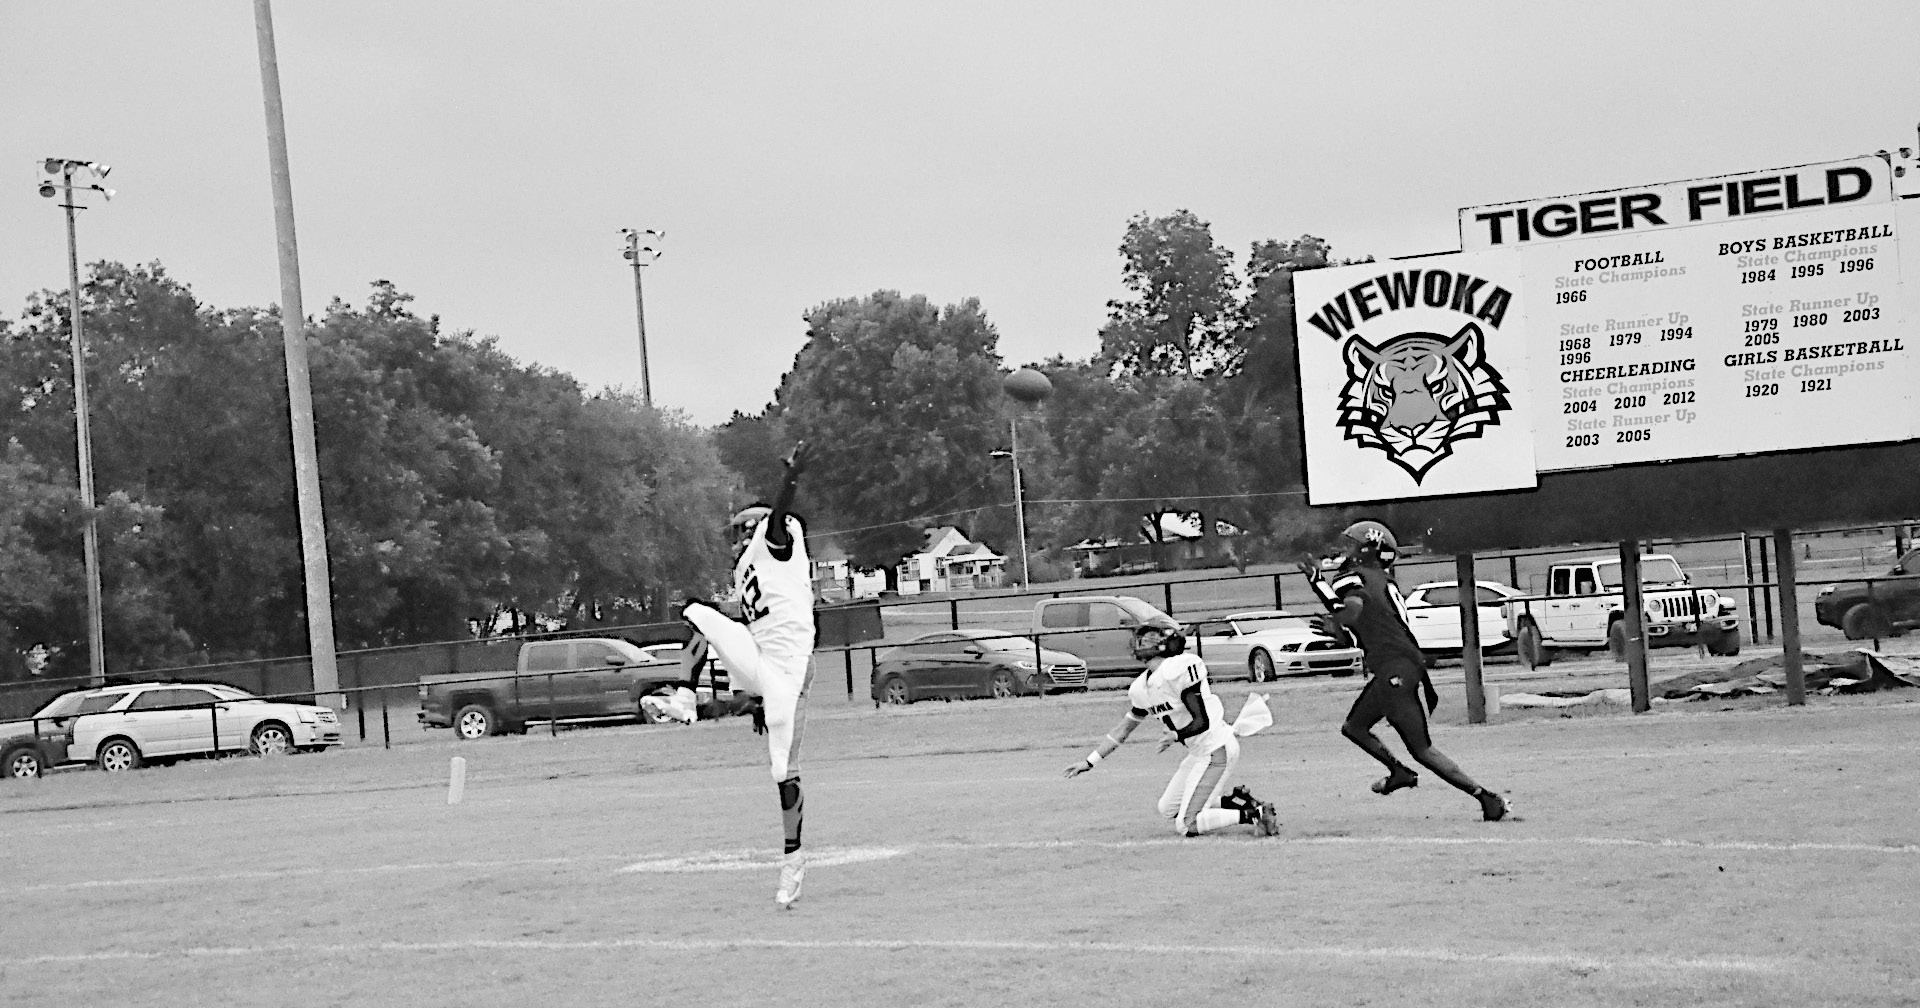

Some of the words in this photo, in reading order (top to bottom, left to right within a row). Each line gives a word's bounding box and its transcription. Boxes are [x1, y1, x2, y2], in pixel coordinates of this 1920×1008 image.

[1476, 192, 1668, 245] TIGER
[1687, 166, 1872, 221] FIELD
[1718, 239, 1766, 256] BOYS
[1773, 225, 1892, 250] BASKETBALL
[1574, 251, 1664, 272] FOOTBALL
[1737, 255, 1779, 268] State
[1784, 244, 1877, 263] Champions
[1555, 276, 1594, 288] State
[1599, 266, 1686, 283] Champions
[1742, 269, 1776, 283] 1984
[1791, 264, 1824, 278] 1995
[1840, 258, 1874, 273] 1996
[1307, 268, 1513, 342] WEWOKA
[1556, 290, 1587, 304] 1966
[1742, 305, 1783, 317] State
[1789, 296, 1851, 313] Runner
[1857, 292, 1879, 307] Up
[1560, 324, 1599, 336] State
[1605, 316, 1663, 332] Runner
[1669, 312, 1688, 326] Up
[1745, 319, 1778, 332] 1979
[1793, 313, 1827, 328] 1980
[1843, 308, 1880, 323] 2003
[1560, 338, 1591, 351] 1968
[1610, 333, 1641, 346] 1979
[1661, 327, 1692, 341] 1994
[1745, 333, 1779, 346] 2005
[1560, 352, 1591, 365] 1996
[1724, 351, 1777, 367] GIRLS
[1784, 339, 1904, 362] BASKETBALL
[1560, 359, 1695, 382] CHEERLEADING
[1745, 369, 1785, 382] State
[1791, 361, 1884, 377] Champions
[1563, 387, 1602, 399] State
[1607, 378, 1695, 395] Champions
[1746, 384, 1779, 397] 1920
[1801, 379, 1831, 392] 1921
[1564, 400, 1597, 414] 2004
[1614, 396, 1646, 409] 2010
[1663, 391, 1695, 405] 2012
[1568, 419, 1606, 431] State
[1613, 412, 1670, 427] Runner
[1676, 409, 1696, 423] Up
[1566, 434, 1599, 447] 2003
[1617, 429, 1650, 443] 2005
[1187, 664, 1199, 682] 11
